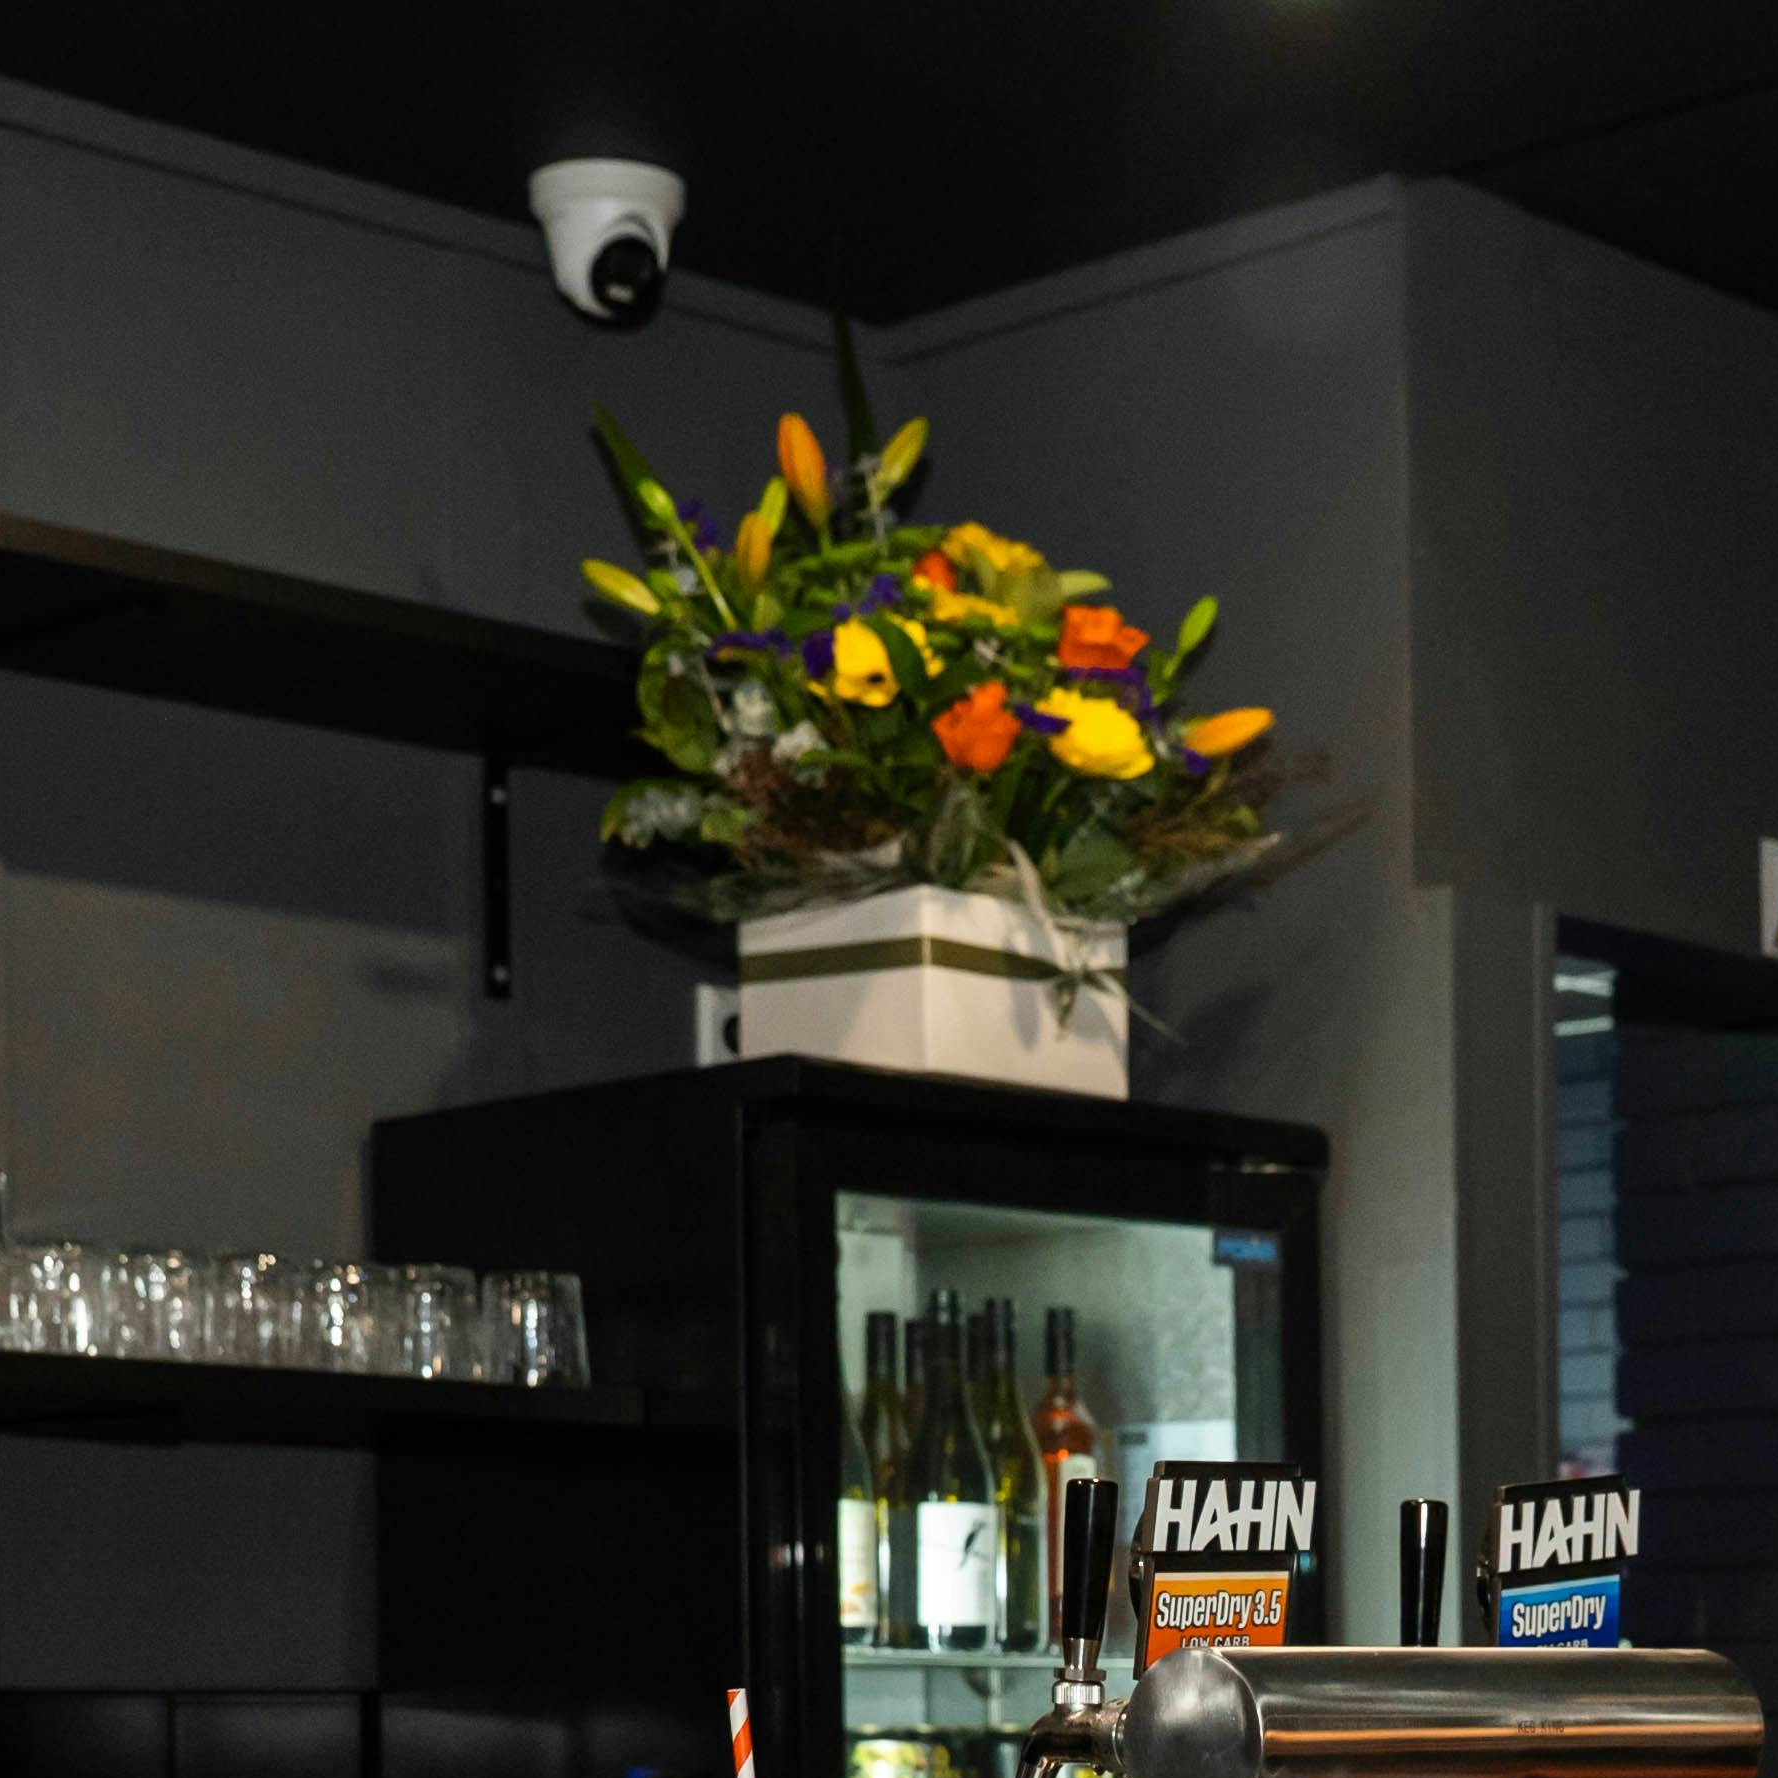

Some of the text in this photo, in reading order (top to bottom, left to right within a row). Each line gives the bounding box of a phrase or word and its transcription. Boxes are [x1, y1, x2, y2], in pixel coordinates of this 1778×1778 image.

[1153, 1479, 1317, 1551] HAHN
[1498, 1489, 1641, 1573] HAHN
[1156, 1589, 1282, 1631] SuperDry 3.5
[1512, 1594, 1606, 1639] SuperDry
